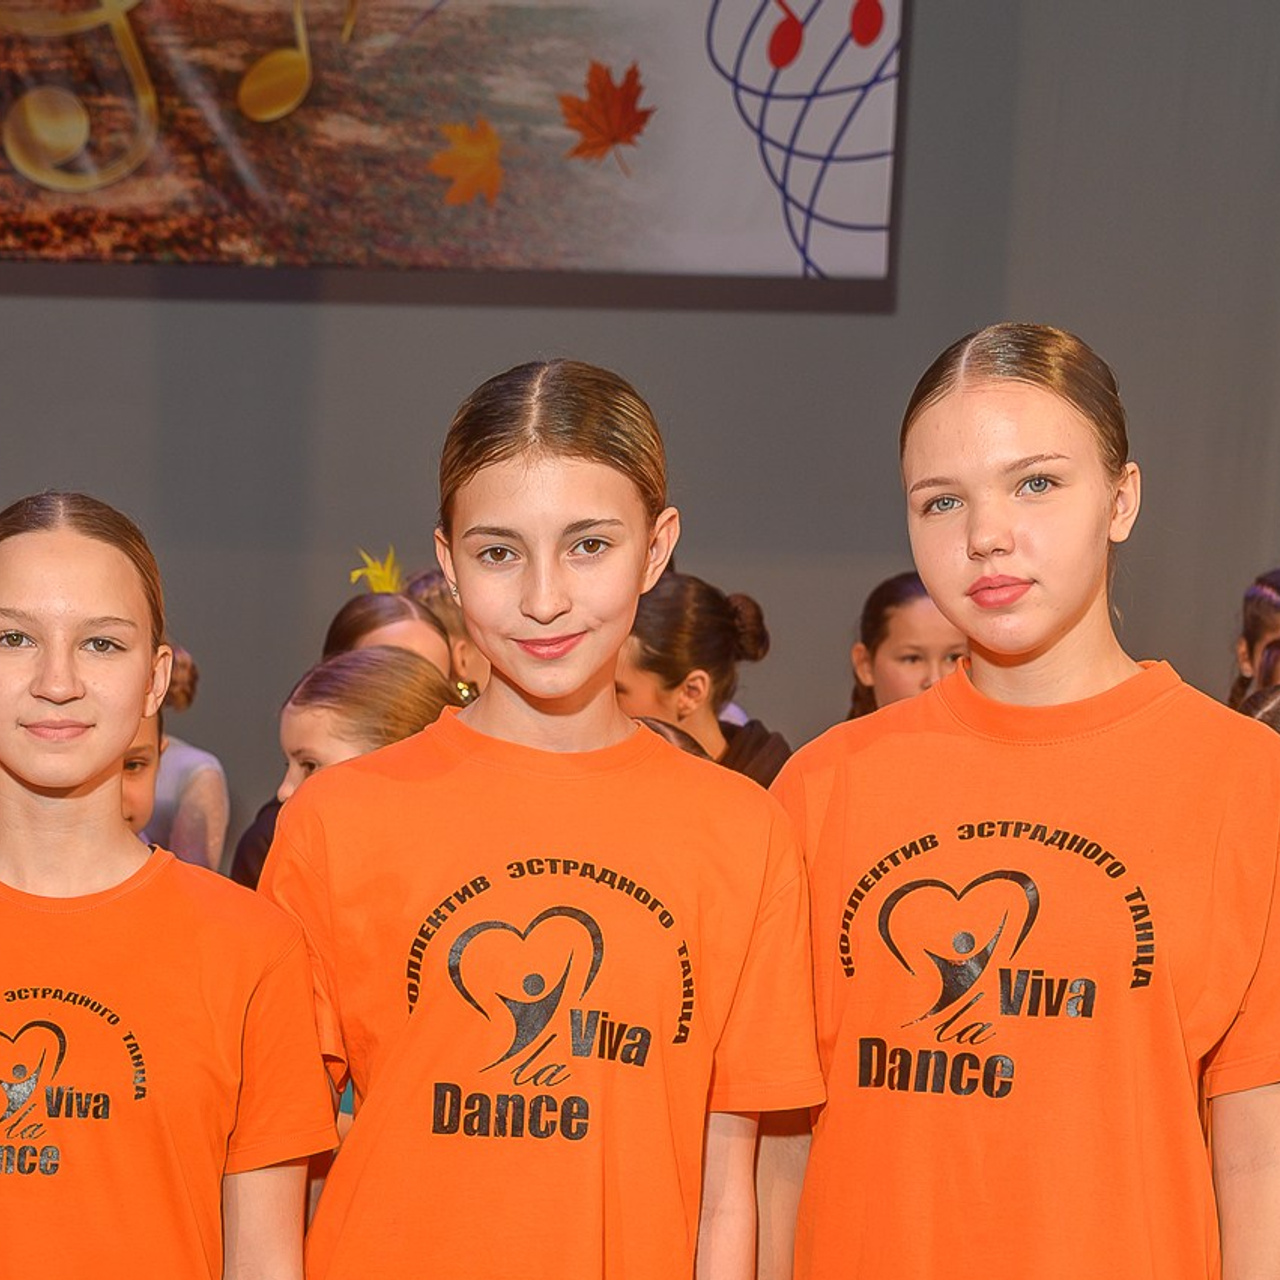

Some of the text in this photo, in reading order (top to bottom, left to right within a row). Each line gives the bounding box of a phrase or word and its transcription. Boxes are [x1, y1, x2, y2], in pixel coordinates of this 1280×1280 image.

[957, 820, 1126, 879] ЭСТРАДНОГО
[1125, 886, 1155, 989] ТАНЦА
[406, 858, 694, 1044] ОЛЛЕКТИВ ЭСТРАДНОГО ТАНЦА
[933, 992, 997, 1045] la
[998, 967, 1097, 1019] Viva
[4, 987, 120, 1026] ЭСТРАДНОГО
[122, 1031, 147, 1100] ТАНЦА
[510, 1033, 571, 1087] la
[570, 1008, 651, 1067] Viva
[858, 1037, 1015, 1099] Dance
[4, 1103, 47, 1139] la
[45, 1086, 110, 1119] Viva
[432, 1082, 589, 1141] Dance
